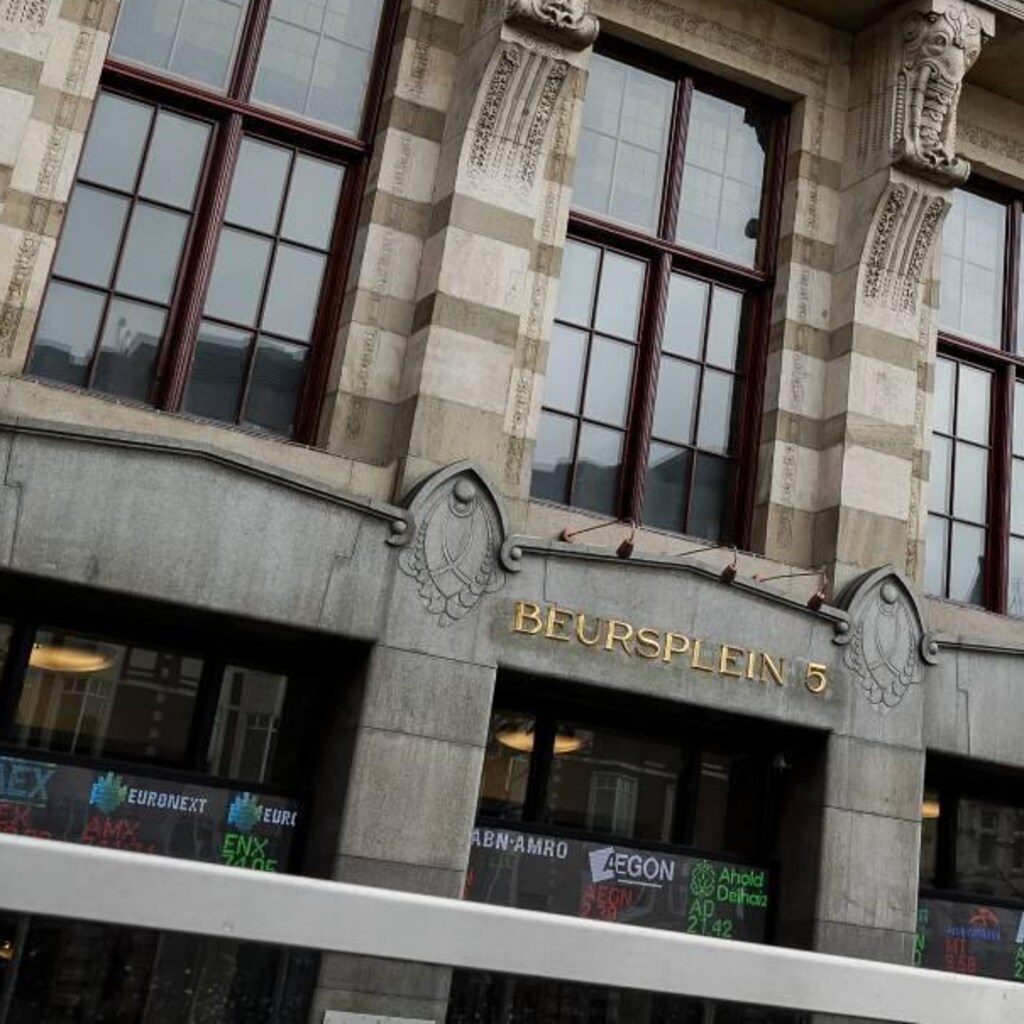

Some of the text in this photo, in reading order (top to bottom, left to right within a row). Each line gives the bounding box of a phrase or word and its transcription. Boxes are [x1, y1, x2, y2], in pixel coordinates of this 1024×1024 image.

[511, 600, 829, 696] BEURSPLEIN 5
[127, 787, 208, 814] EURONEXT
[222, 833, 270, 860] ENX
[603, 850, 675, 882] AEGON
[718, 867, 765, 889] Ahold
[688, 900, 715, 919] AD
